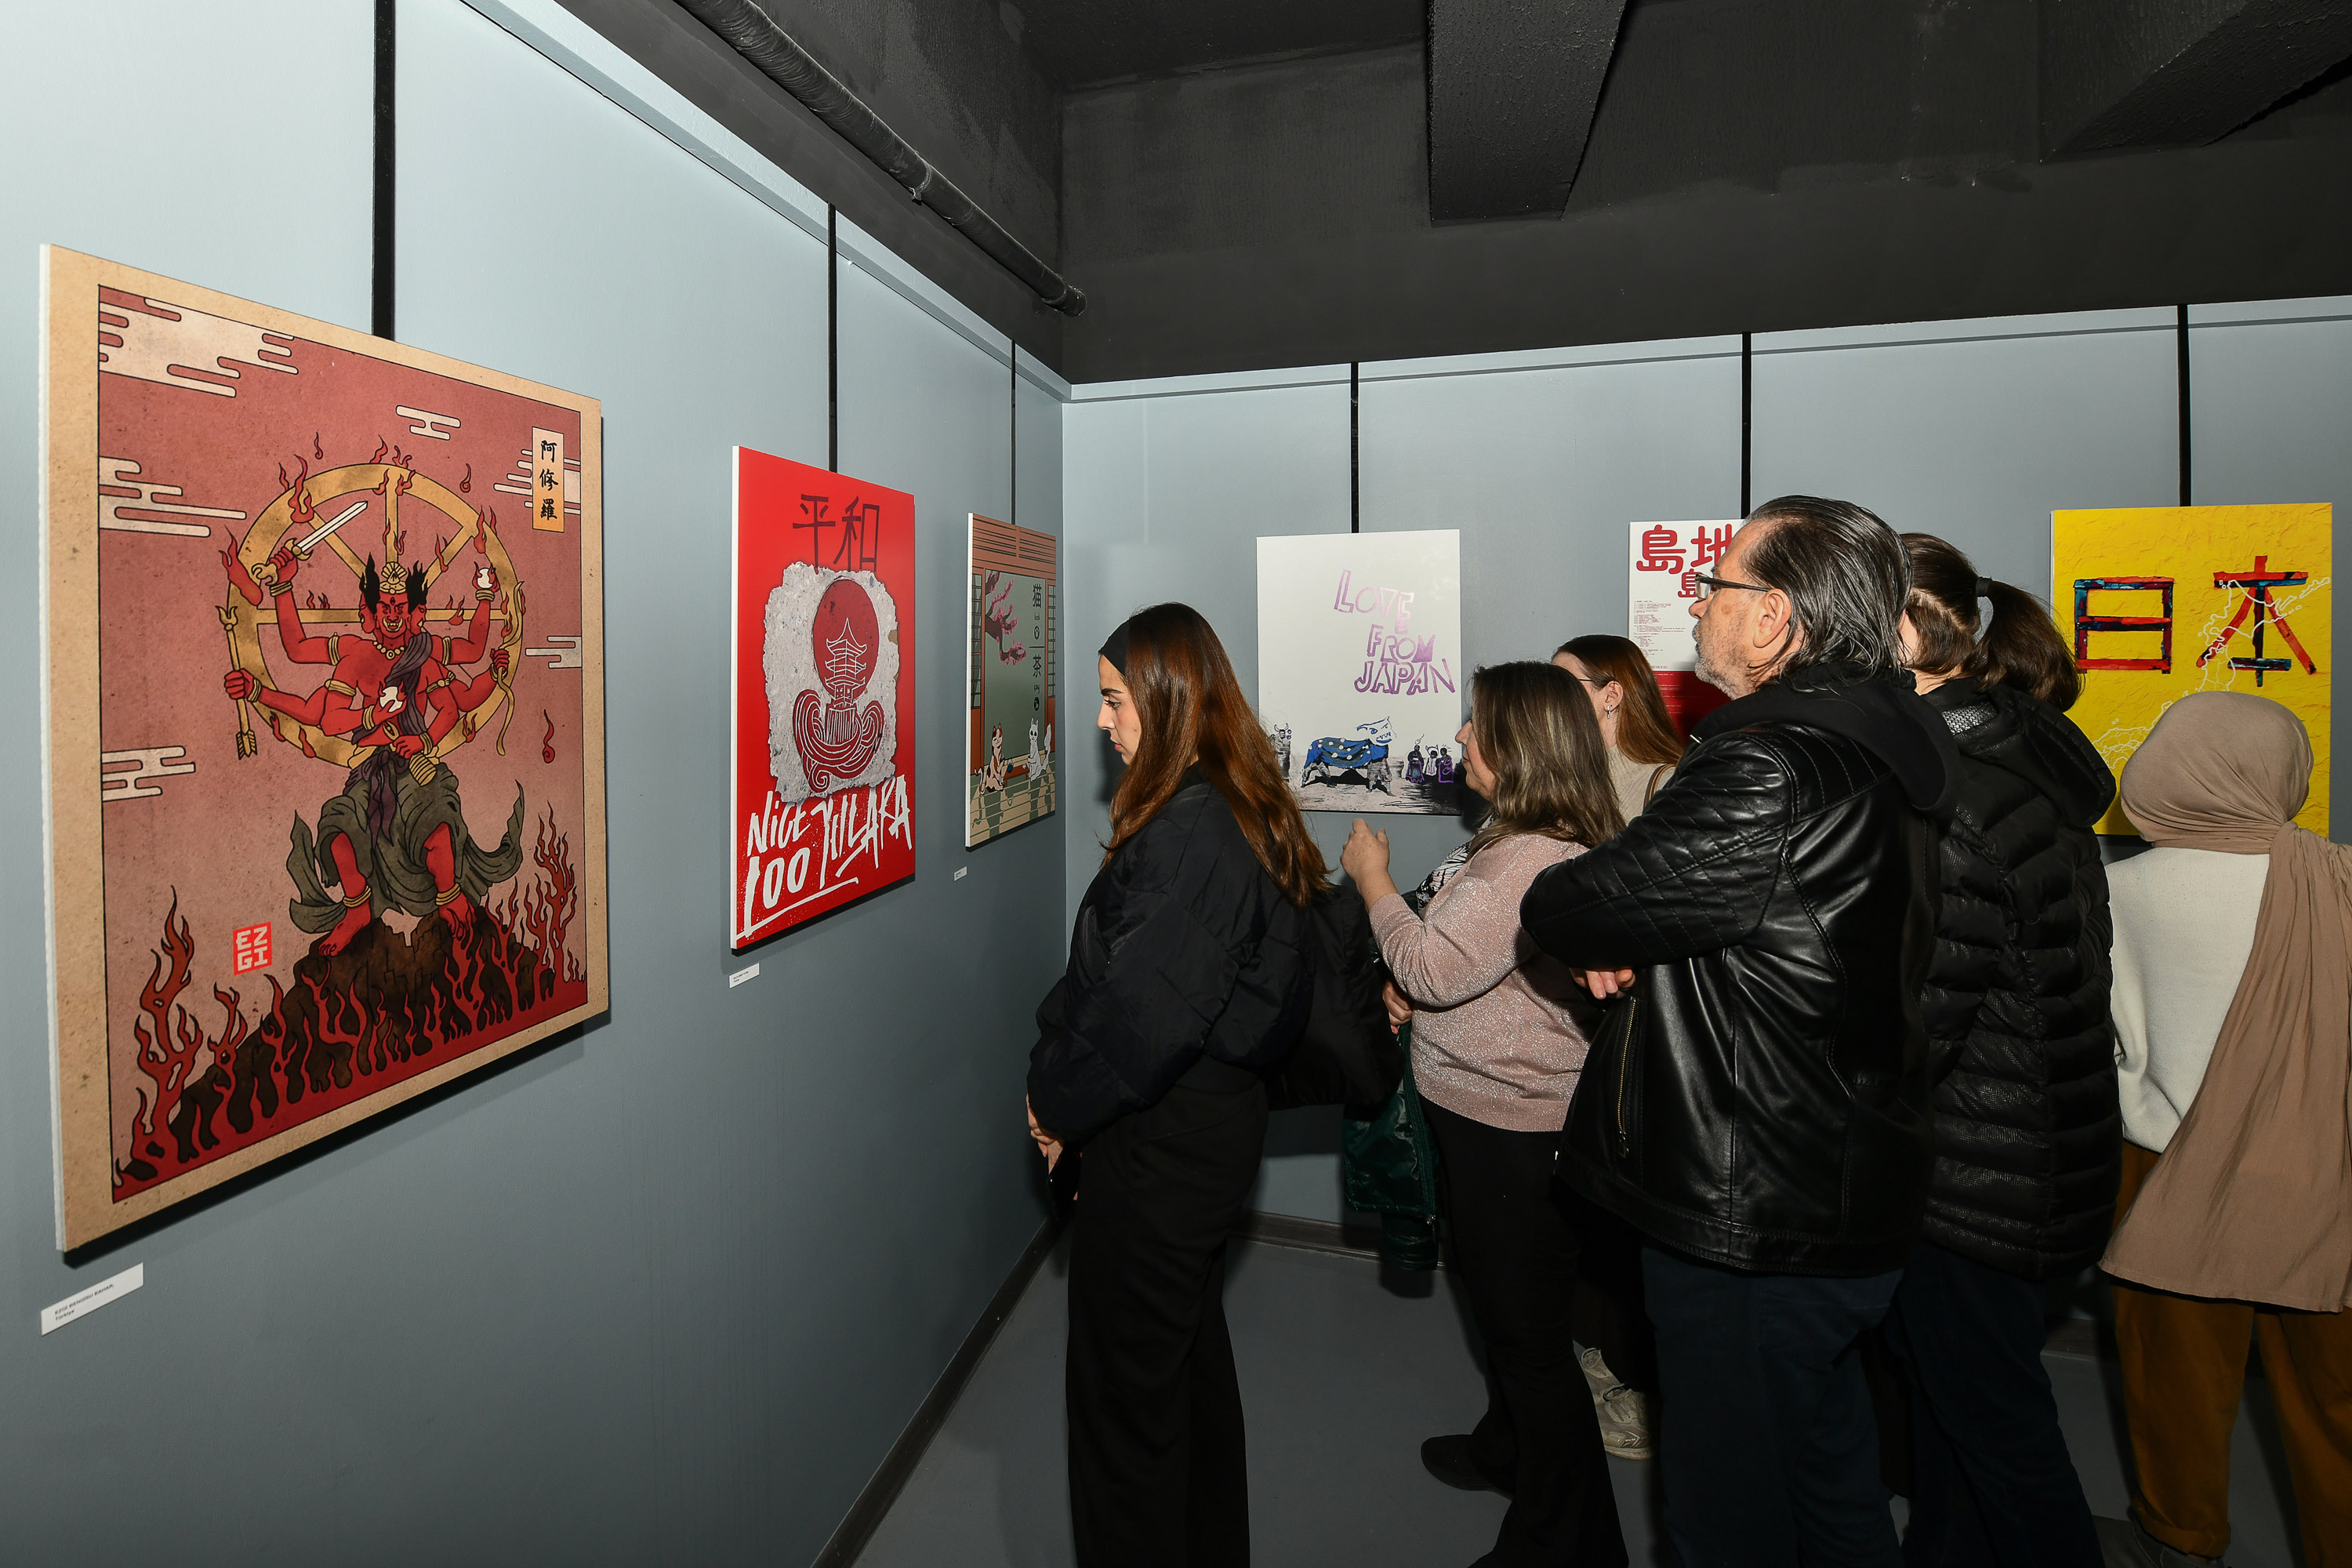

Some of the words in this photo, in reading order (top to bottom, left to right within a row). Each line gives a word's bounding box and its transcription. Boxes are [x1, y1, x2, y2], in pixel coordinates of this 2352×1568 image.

[539, 440, 559, 521] 阿修羅
[793, 494, 880, 575] 平和
[1032, 583, 1042, 608] 猫
[1334, 569, 1414, 634] LOVE
[1367, 624, 1436, 662] FROM
[2073, 555, 2318, 688] 日本
[1033, 654, 1042, 677] 茶
[1354, 659, 1455, 695] JAPAN
